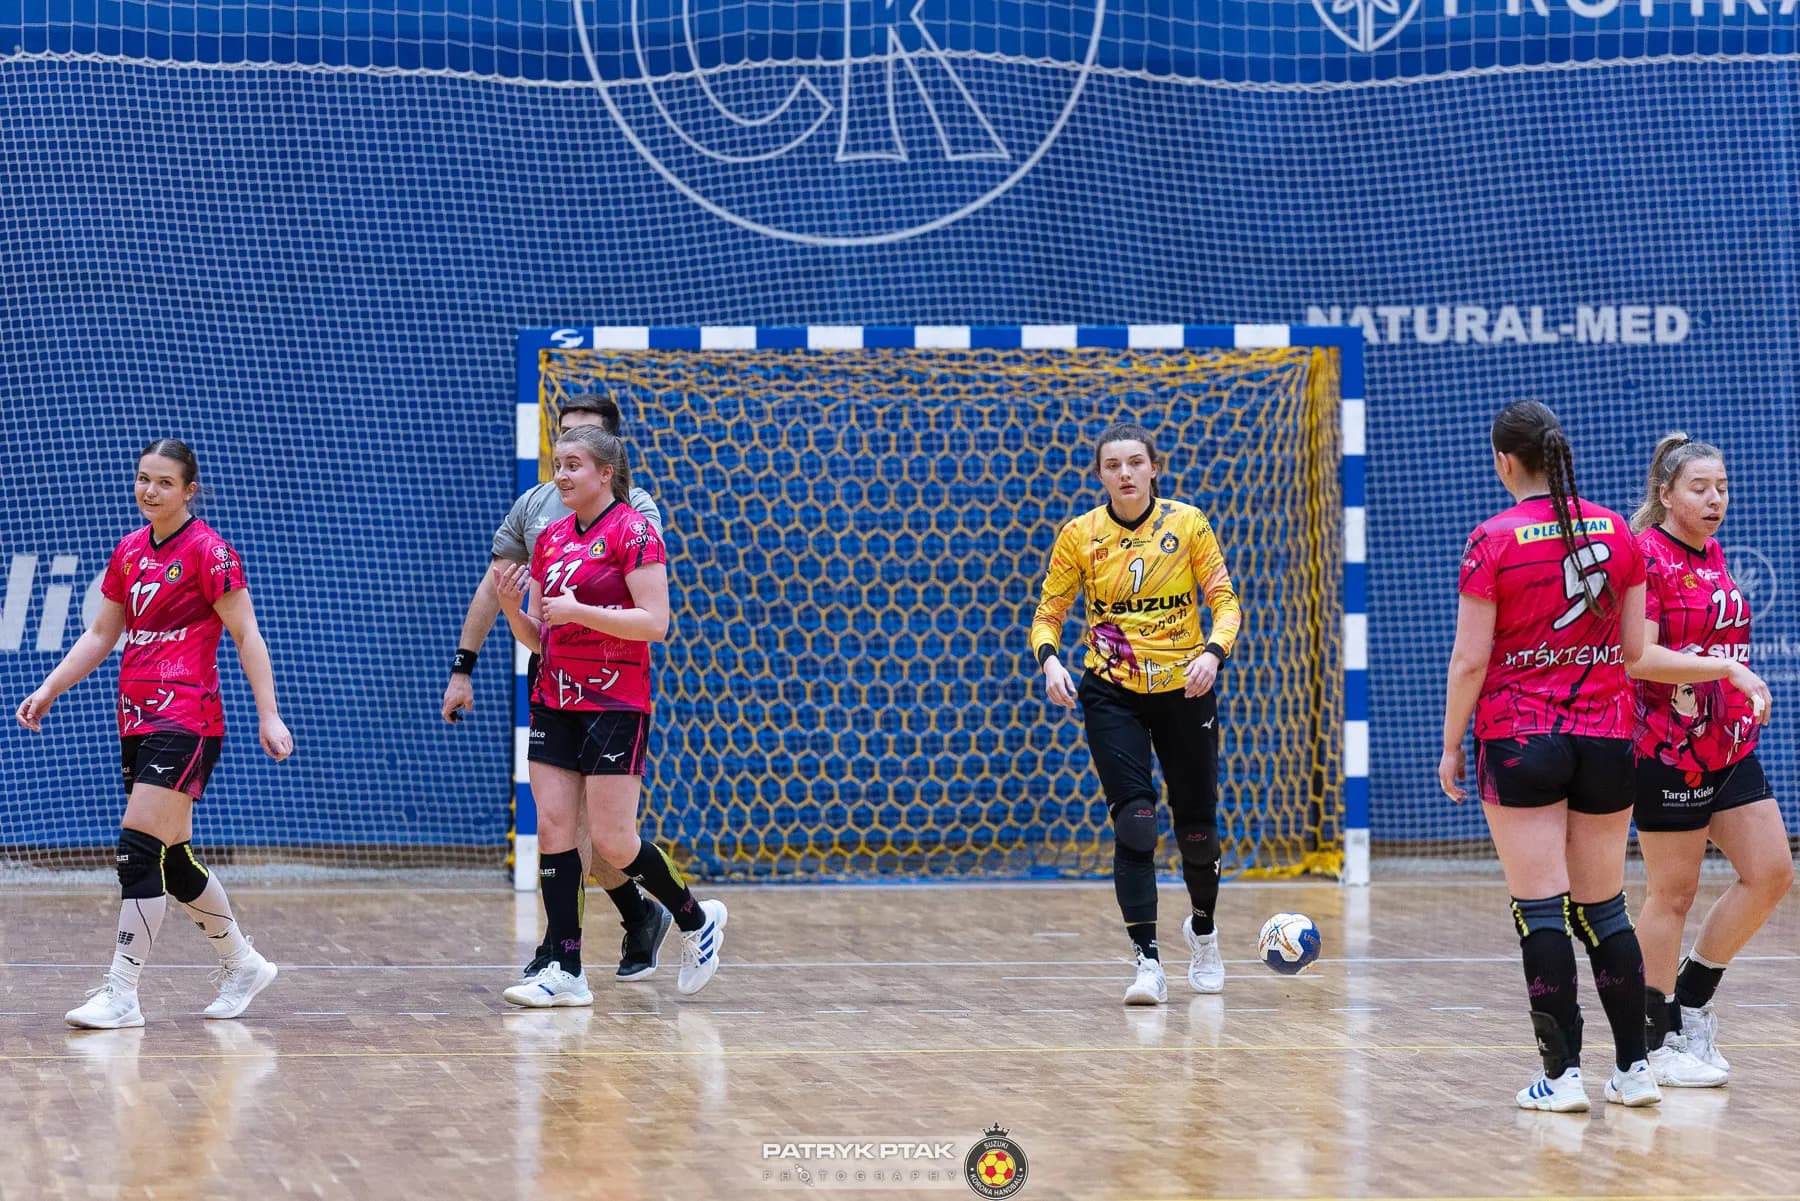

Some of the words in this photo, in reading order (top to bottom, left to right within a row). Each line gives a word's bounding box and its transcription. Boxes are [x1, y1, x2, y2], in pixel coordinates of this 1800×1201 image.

[1307, 305, 1690, 345] NATURAL-MED
[1542, 520, 1607, 537] LEATAN
[1129, 557, 1145, 595] 1
[1553, 542, 1611, 631] 5
[130, 581, 161, 617] 17
[1110, 591, 1193, 615] SUZUKI
[1711, 589, 1750, 630] 22
[128, 627, 188, 646] UZUKI
[1662, 789, 1690, 802] Targi
